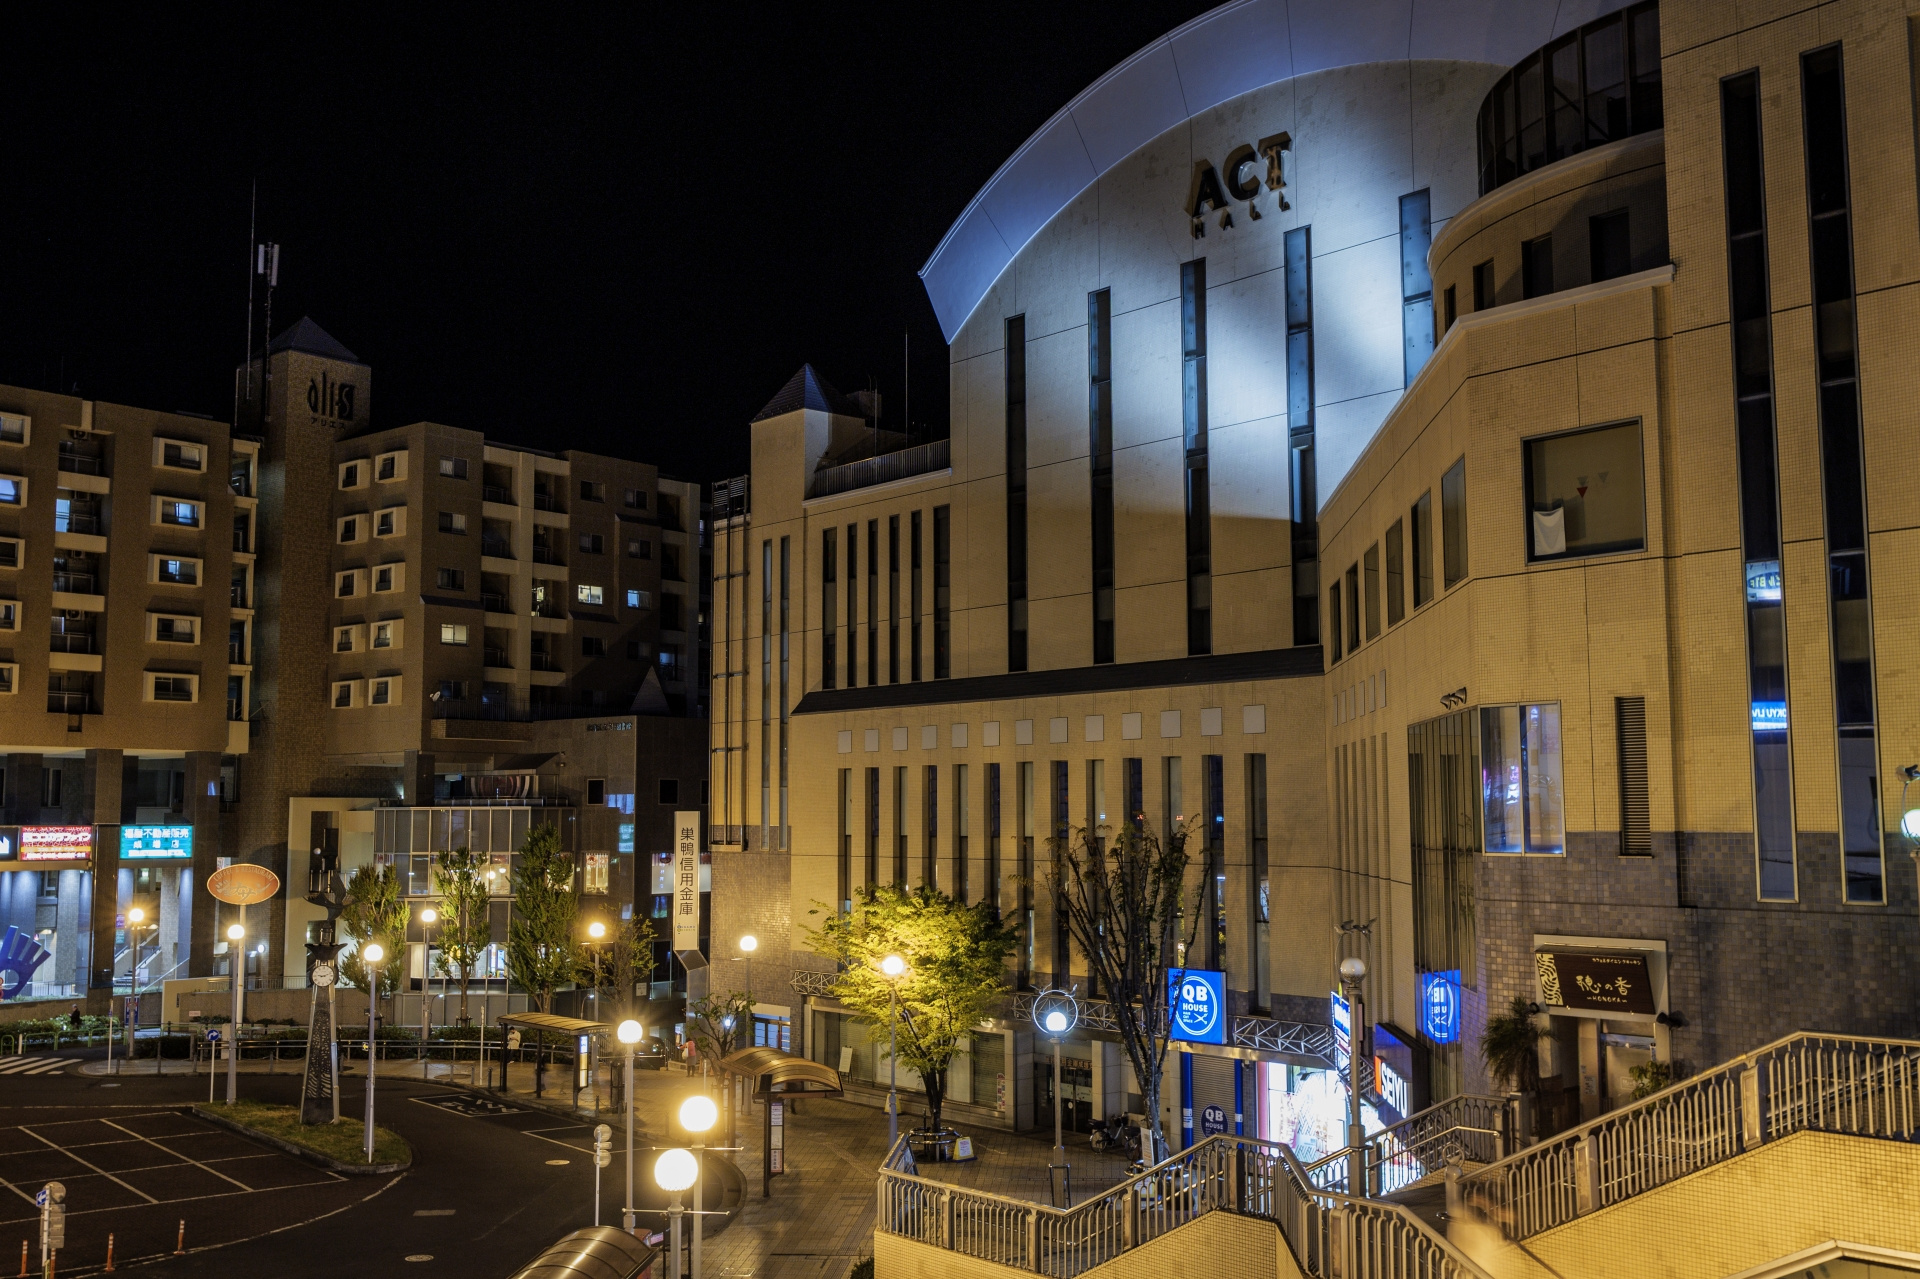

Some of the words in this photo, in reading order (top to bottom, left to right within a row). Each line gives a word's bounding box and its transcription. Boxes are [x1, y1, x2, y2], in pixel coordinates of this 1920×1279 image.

[1184, 131, 1292, 218] ACT
[1191, 190, 1291, 240] HALL
[241, 867, 275, 881] RESTAURANT
[679, 827, 695, 916] 巣鴨信用金庫
[1182, 984, 1208, 1003] QB
[1182, 1002, 1208, 1012] HOUSE
[1381, 1062, 1407, 1119] SEIYU
[1205, 1109, 1224, 1122] QB
[1205, 1121, 1224, 1130] HOUSE
